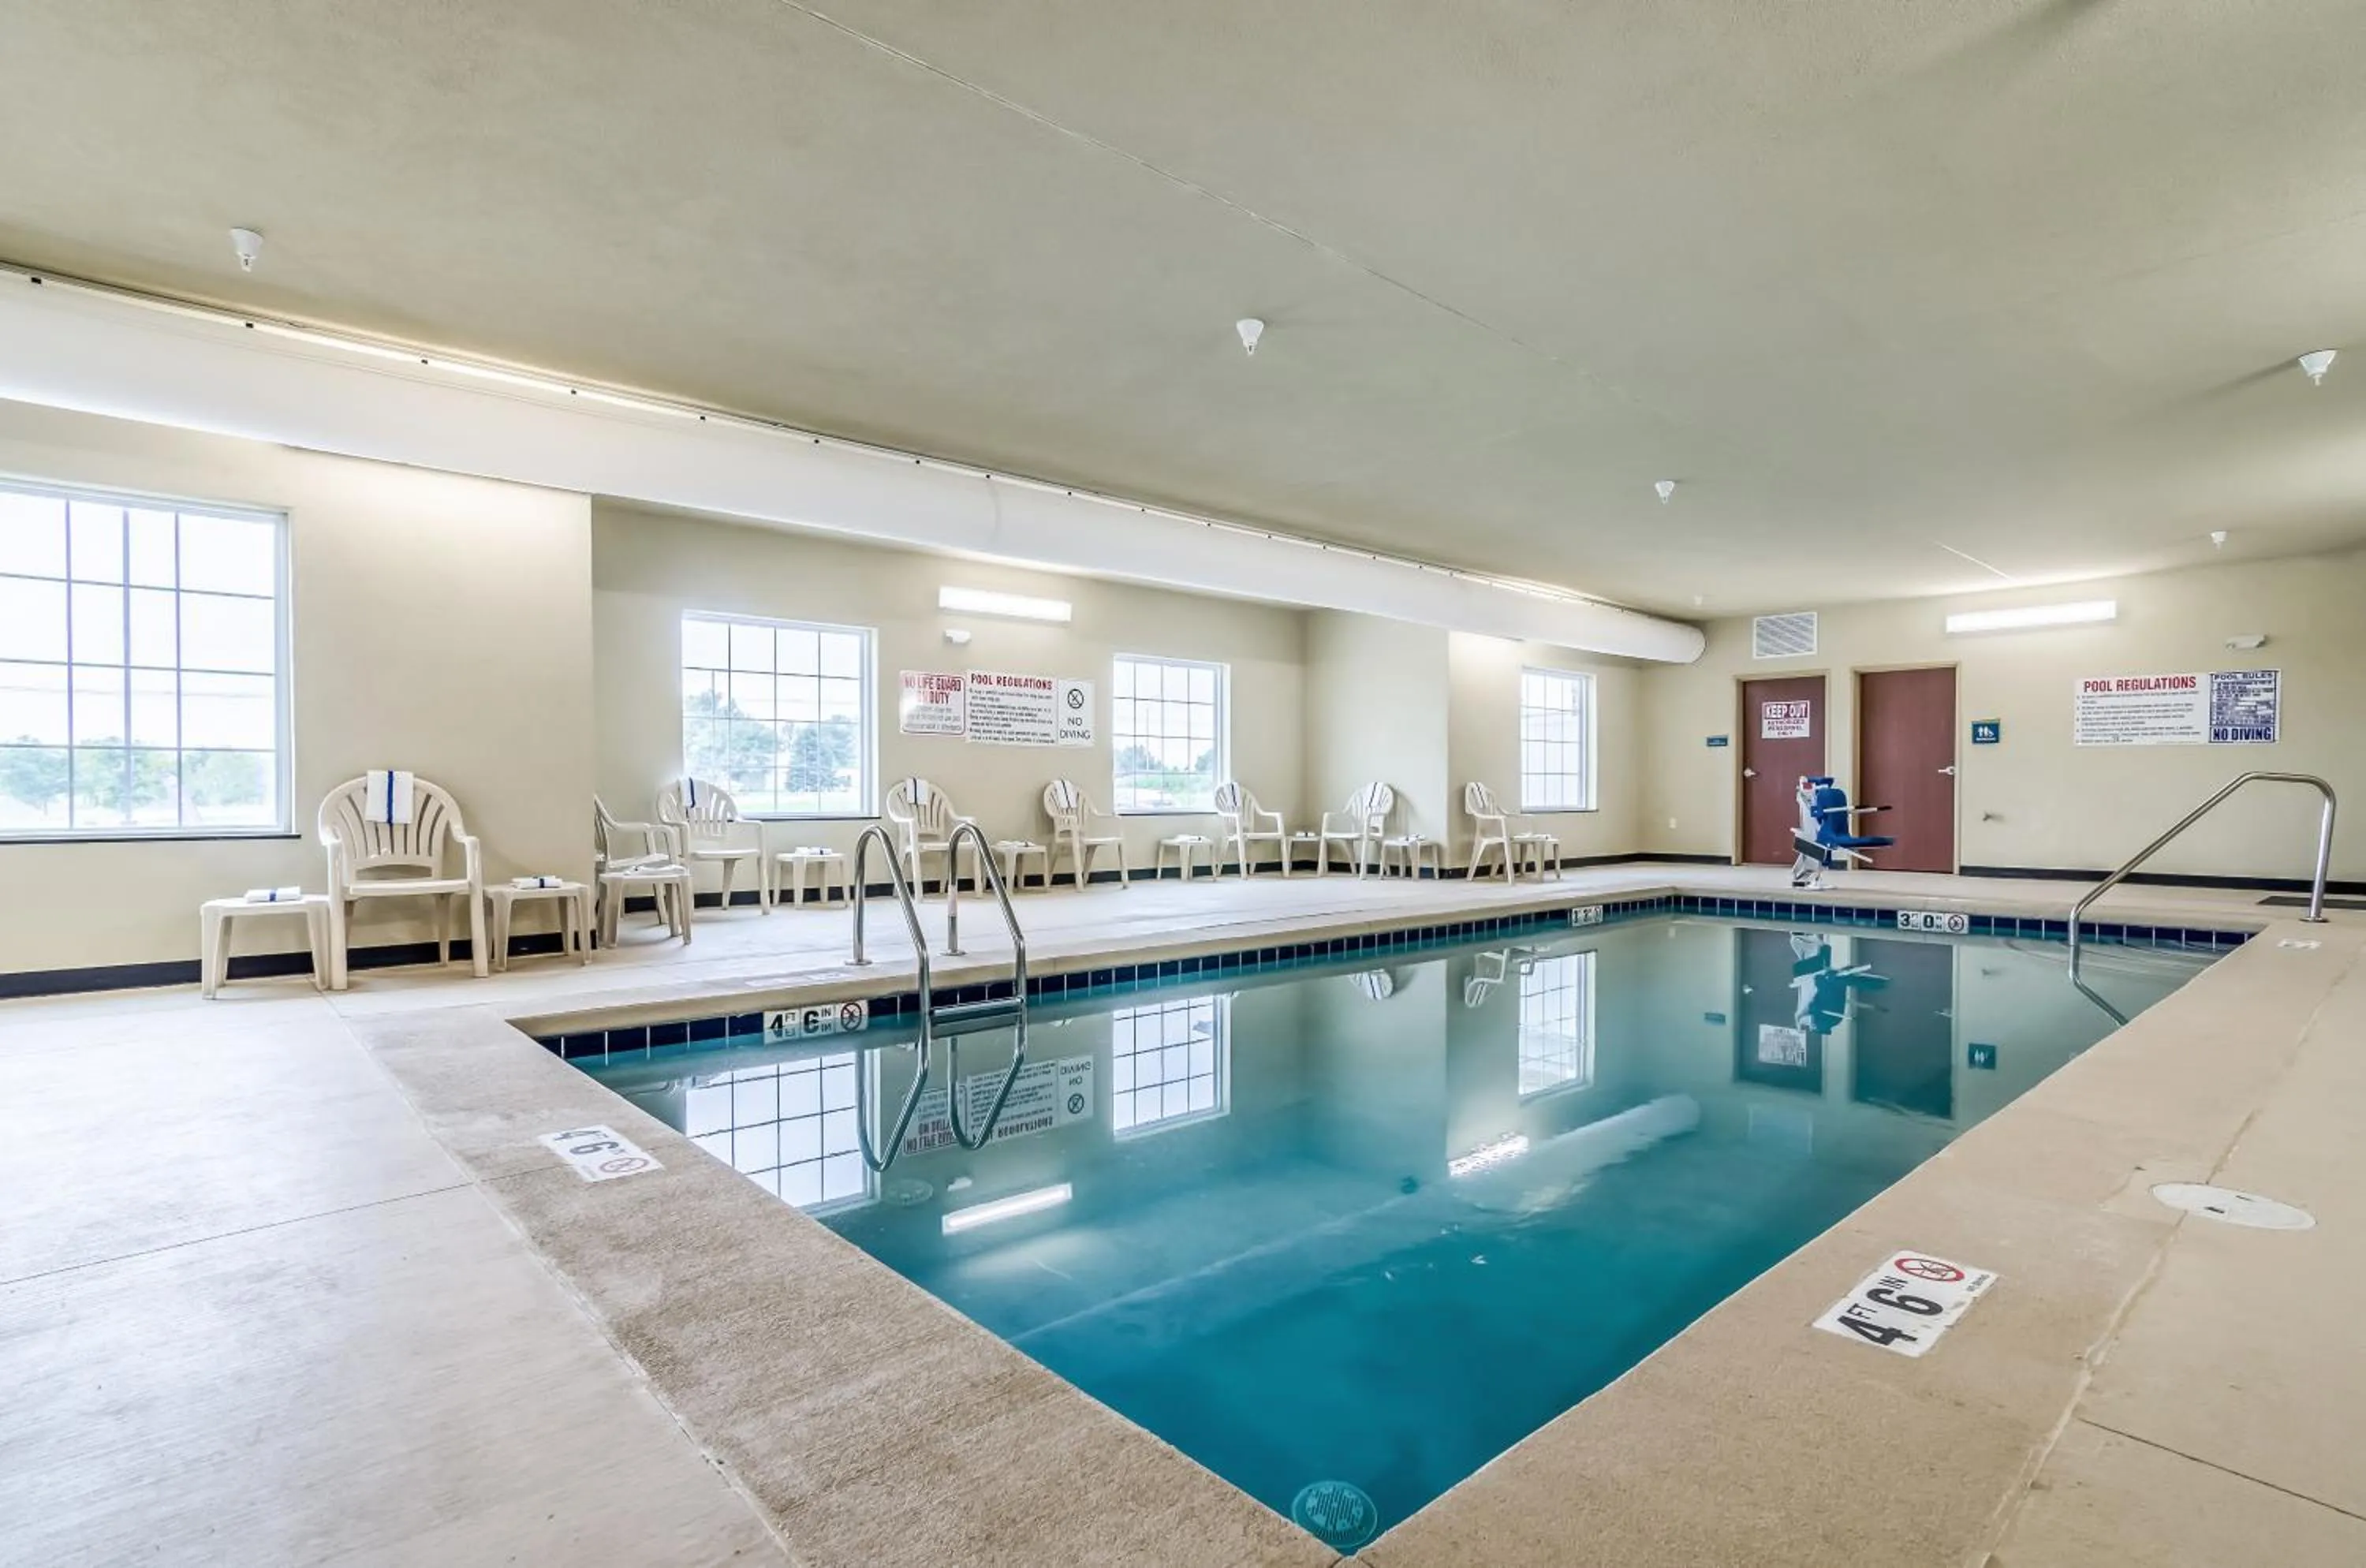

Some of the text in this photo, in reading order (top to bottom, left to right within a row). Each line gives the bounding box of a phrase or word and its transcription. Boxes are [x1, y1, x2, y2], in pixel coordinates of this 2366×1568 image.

[917, 677, 934, 689] LIFE
[936, 678, 961, 692] GUARD
[971, 674, 1053, 690] POOL REGULATIONS
[2084, 676, 2196, 693] POOL REGULATIONS
[929, 691, 950, 704] DUTY
[1767, 704, 1806, 718] KEEP OUT
[1067, 717, 1083, 726] NO
[1059, 729, 1091, 740] DIVING
[2213, 726, 2271, 741] NO DIVING
[1900, 913, 1911, 927] 3
[1923, 914, 1935, 928] 0
[569, 1141, 619, 1155] 6
[1867, 1288, 1943, 1316] 6
[1846, 1303, 1877, 1320] FT
[1837, 1315, 1917, 1346] 4
